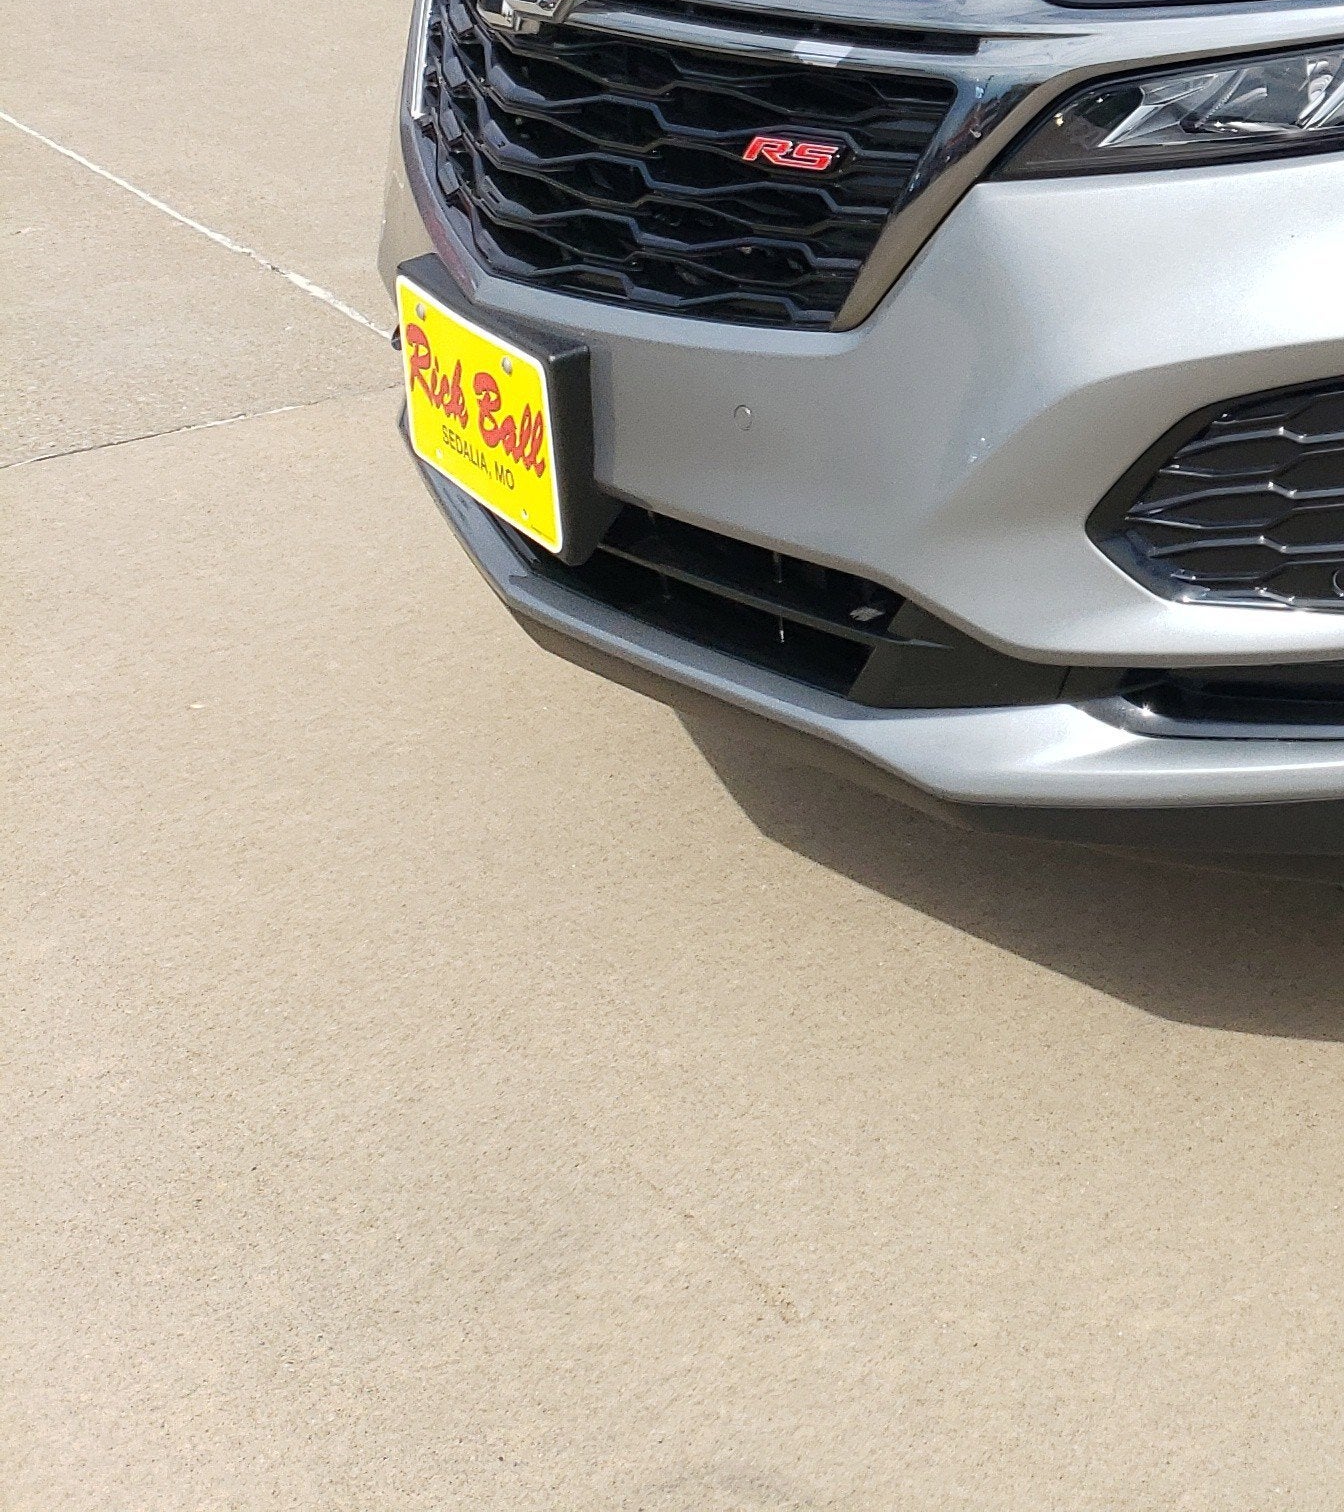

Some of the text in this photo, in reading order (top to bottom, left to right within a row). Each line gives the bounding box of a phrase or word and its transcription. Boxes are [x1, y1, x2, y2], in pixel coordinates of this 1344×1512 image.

[742, 137, 839, 170] RS
[406, 323, 547, 478] Rick Ball
[441, 424, 515, 490] SEDALIA, MO
